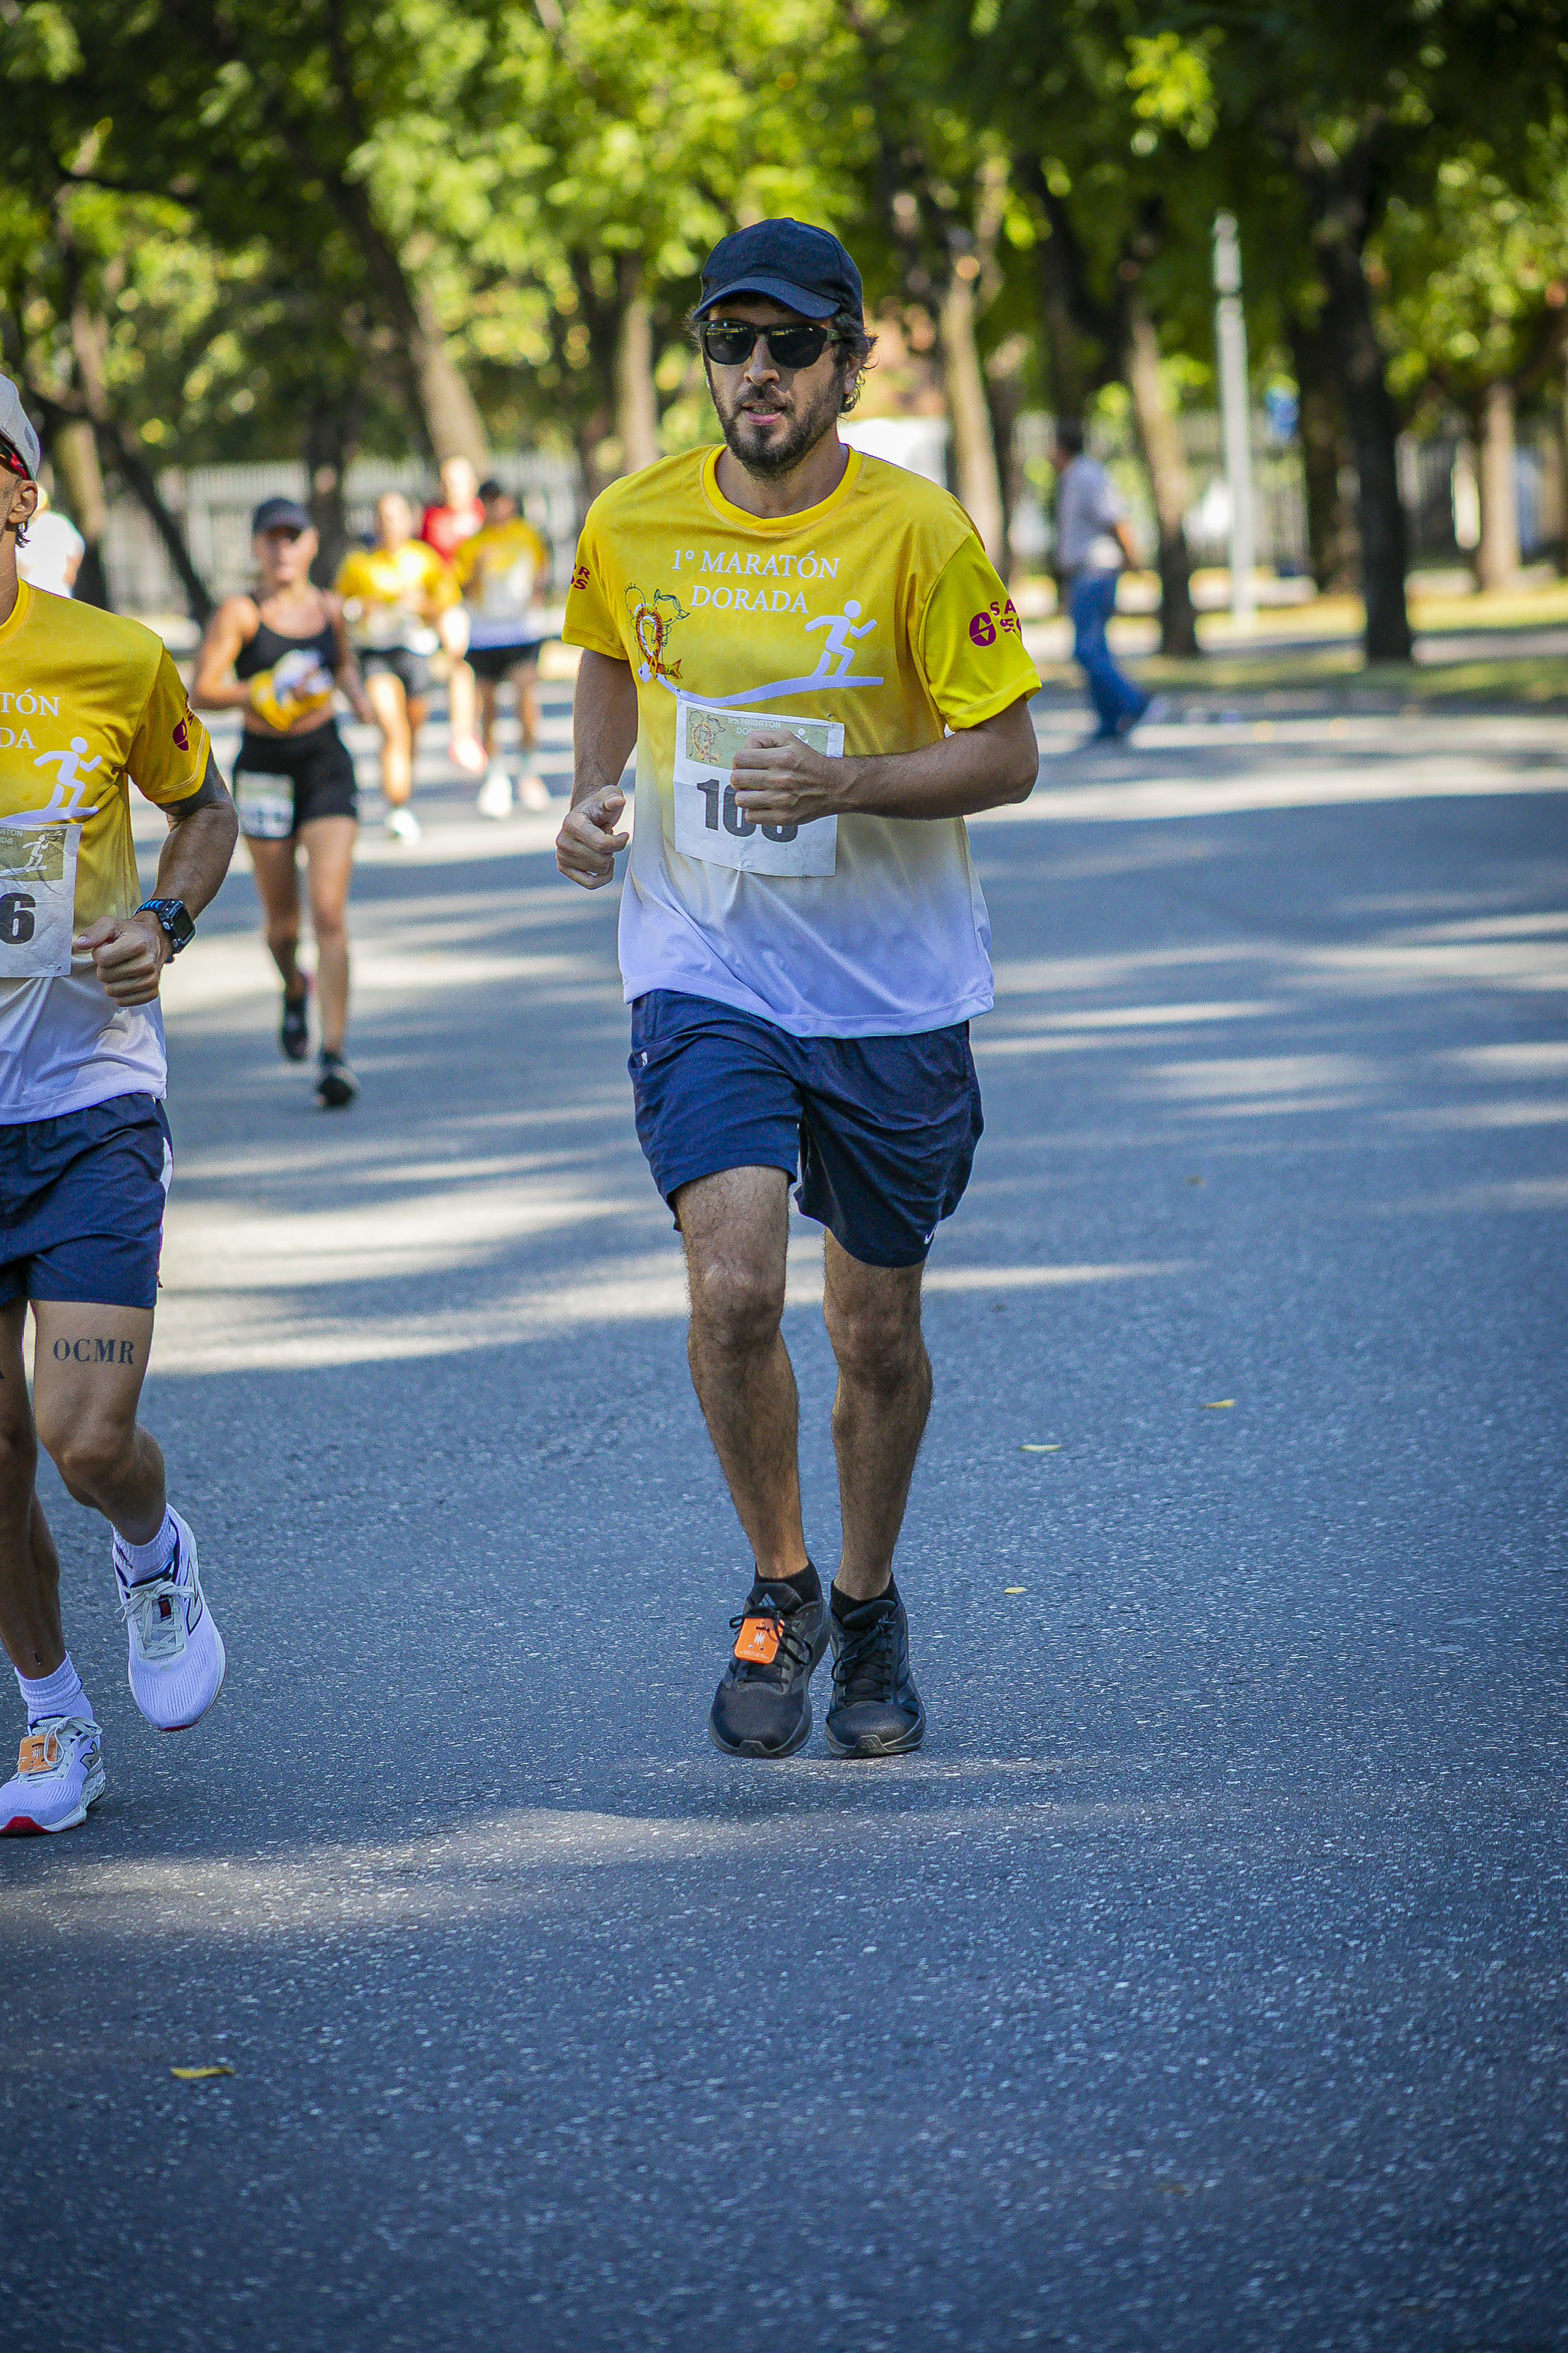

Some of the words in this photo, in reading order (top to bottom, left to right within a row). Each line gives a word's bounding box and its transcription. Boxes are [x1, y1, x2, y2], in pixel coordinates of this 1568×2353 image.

[699, 549, 840, 579] MARATÓN
[690, 585, 808, 614] DORADA
[0, 892, 36, 944] 6
[53, 1338, 135, 1364] OCMR
